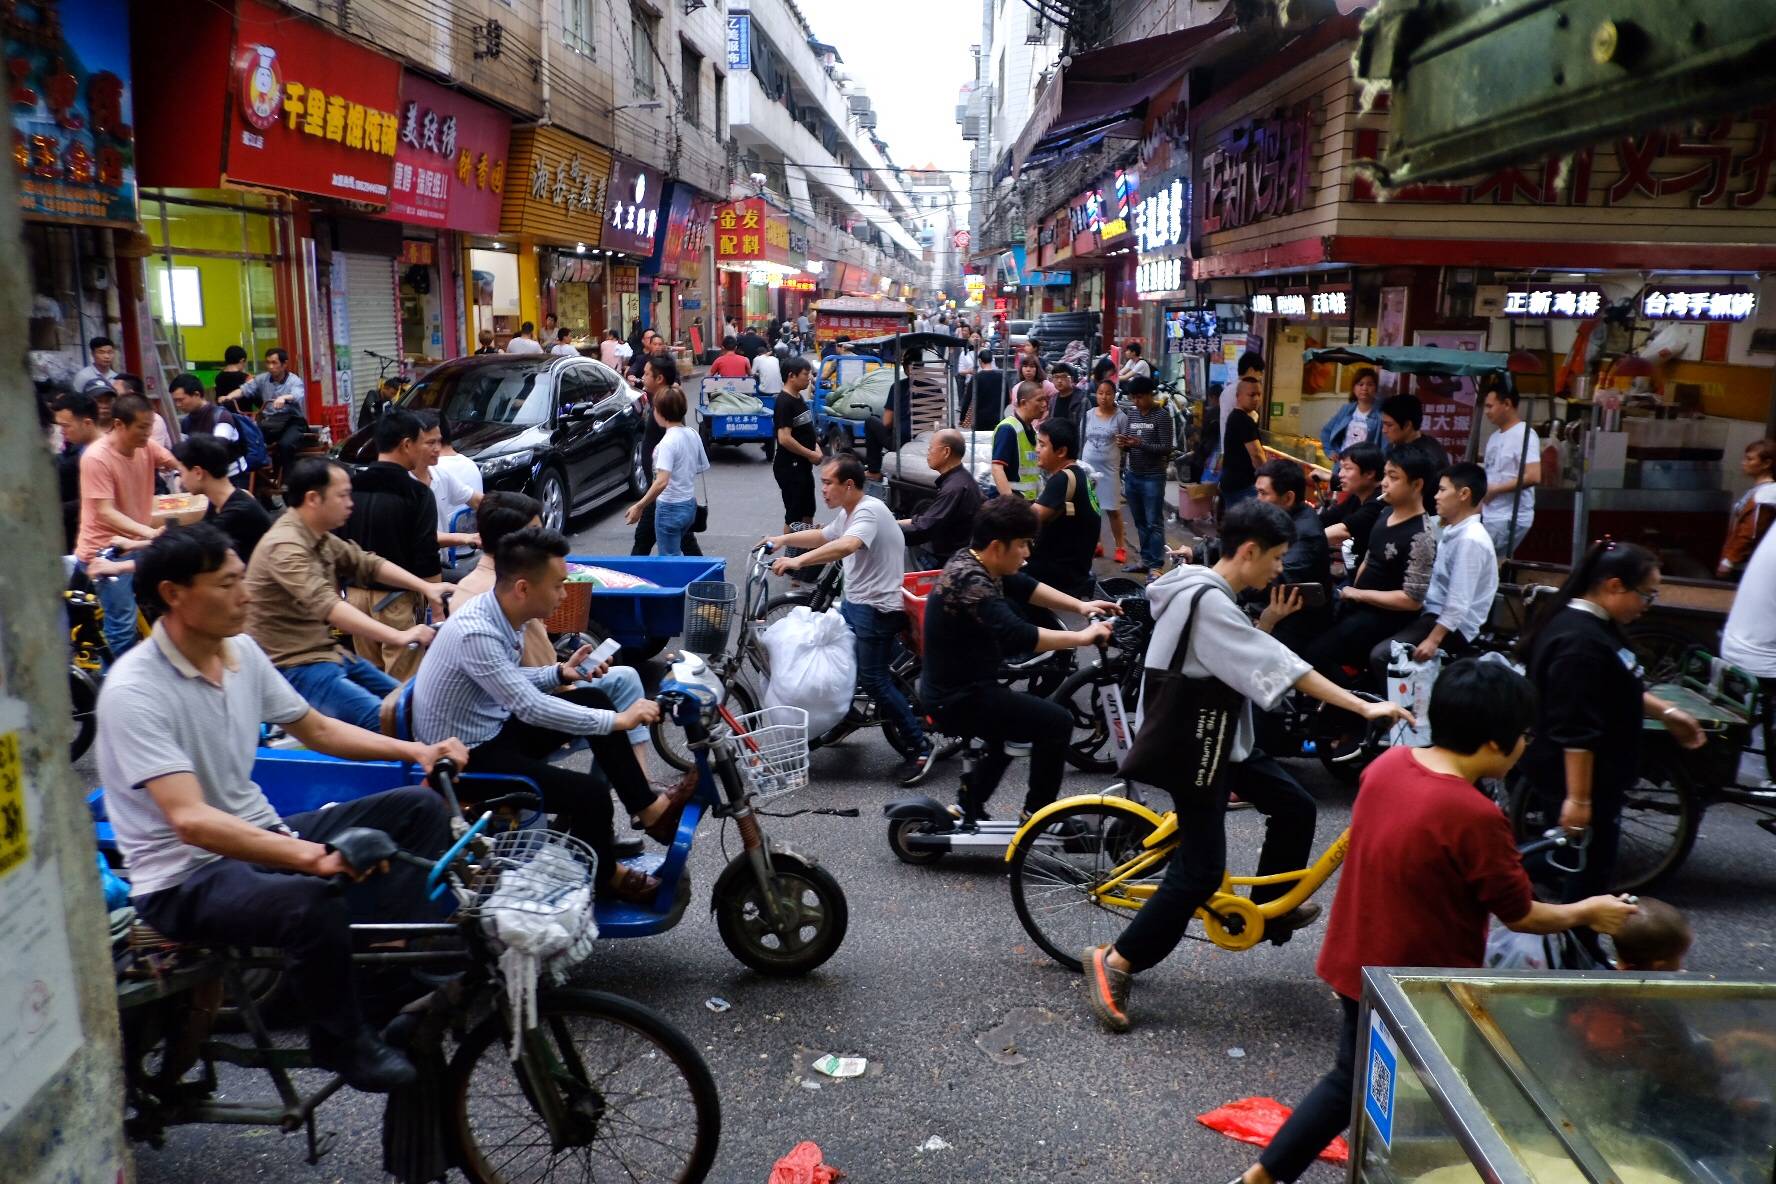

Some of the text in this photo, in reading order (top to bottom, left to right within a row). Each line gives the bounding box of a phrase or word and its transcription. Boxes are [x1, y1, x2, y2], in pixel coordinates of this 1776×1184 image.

[720, 209, 760, 230] 金发
[719, 235, 760, 255] 配料
[1504, 291, 1601, 316] 正新鸡排
[1644, 292, 1756, 320] 台湾手抓饼
[1168, 337, 1220, 354] 监控安装
